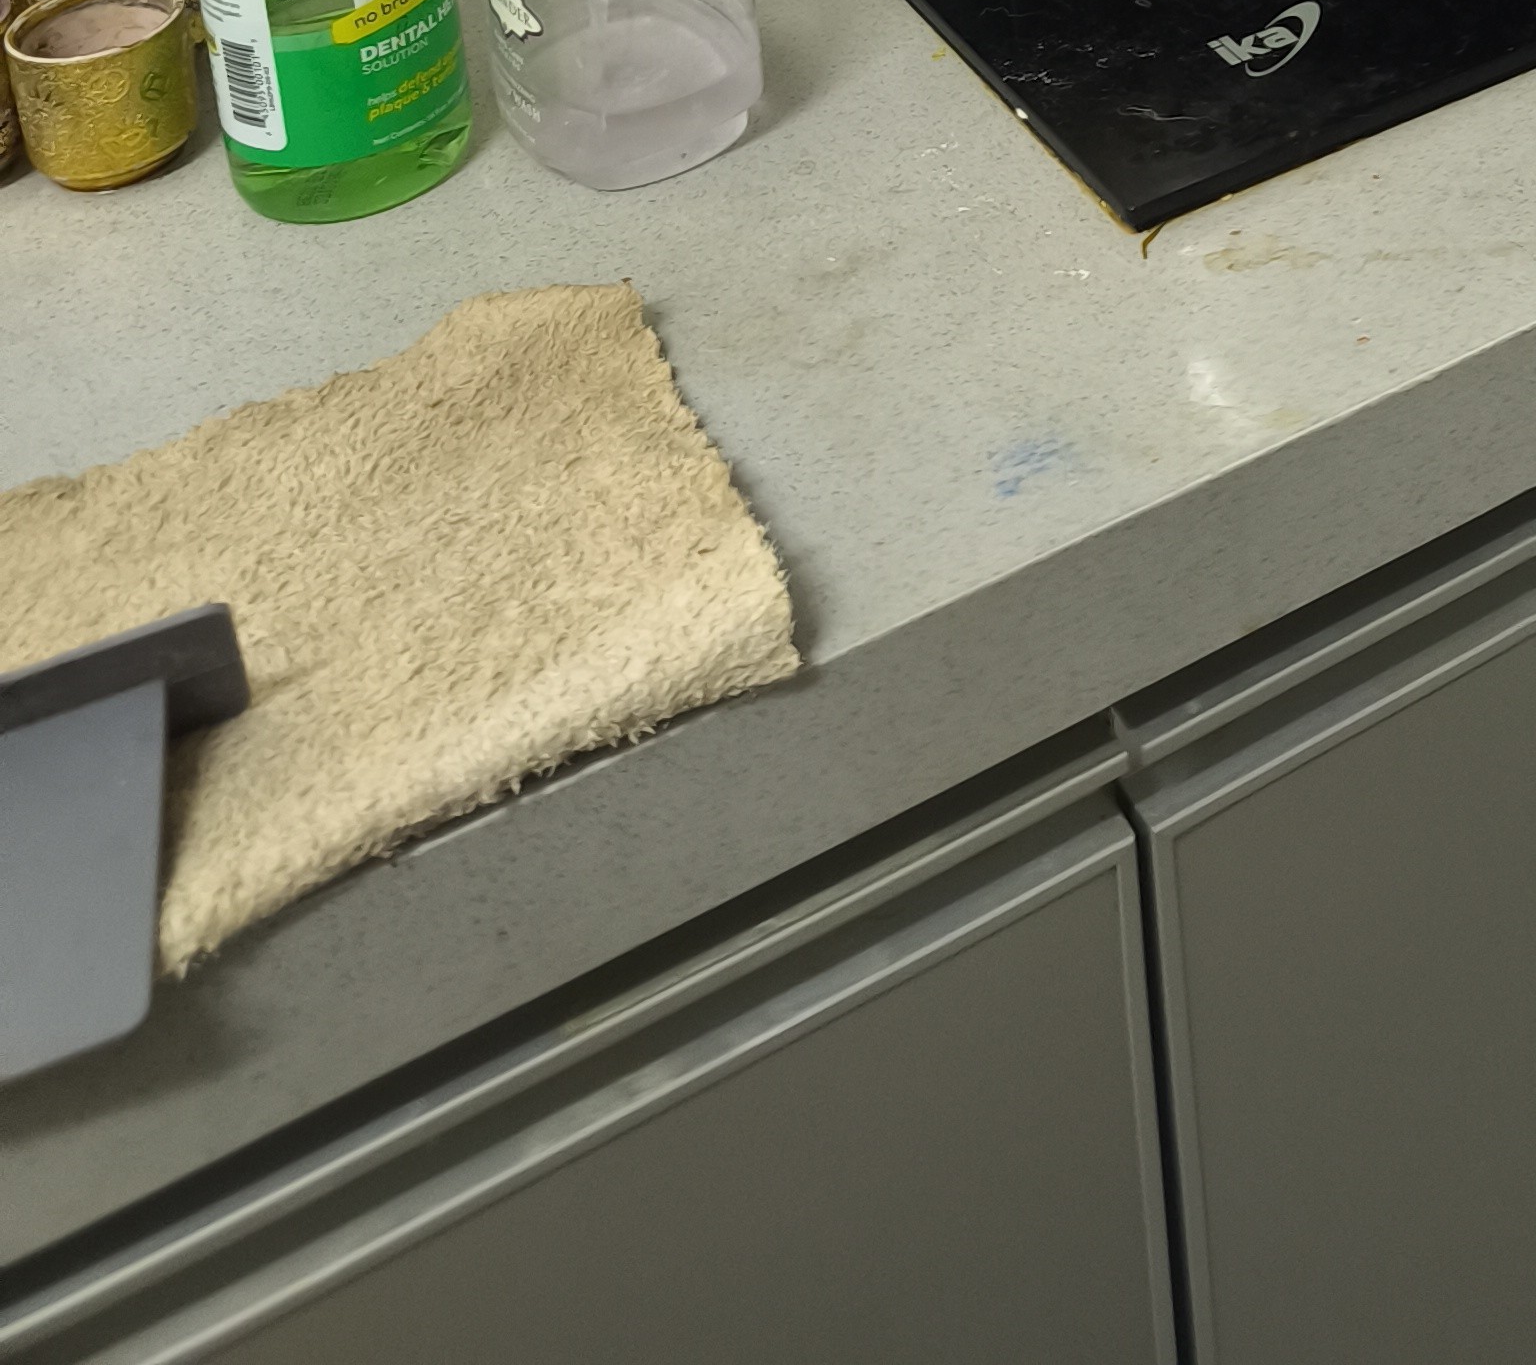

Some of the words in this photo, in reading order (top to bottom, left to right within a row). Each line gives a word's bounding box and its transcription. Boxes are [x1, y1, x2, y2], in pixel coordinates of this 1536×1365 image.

[354, 10, 378, 29] no
[359, 14, 438, 63] DENTAL
[361, 36, 429, 75] SOLUTION
[1206, 26, 1300, 66] ika
[367, 88, 420, 122] plaque
